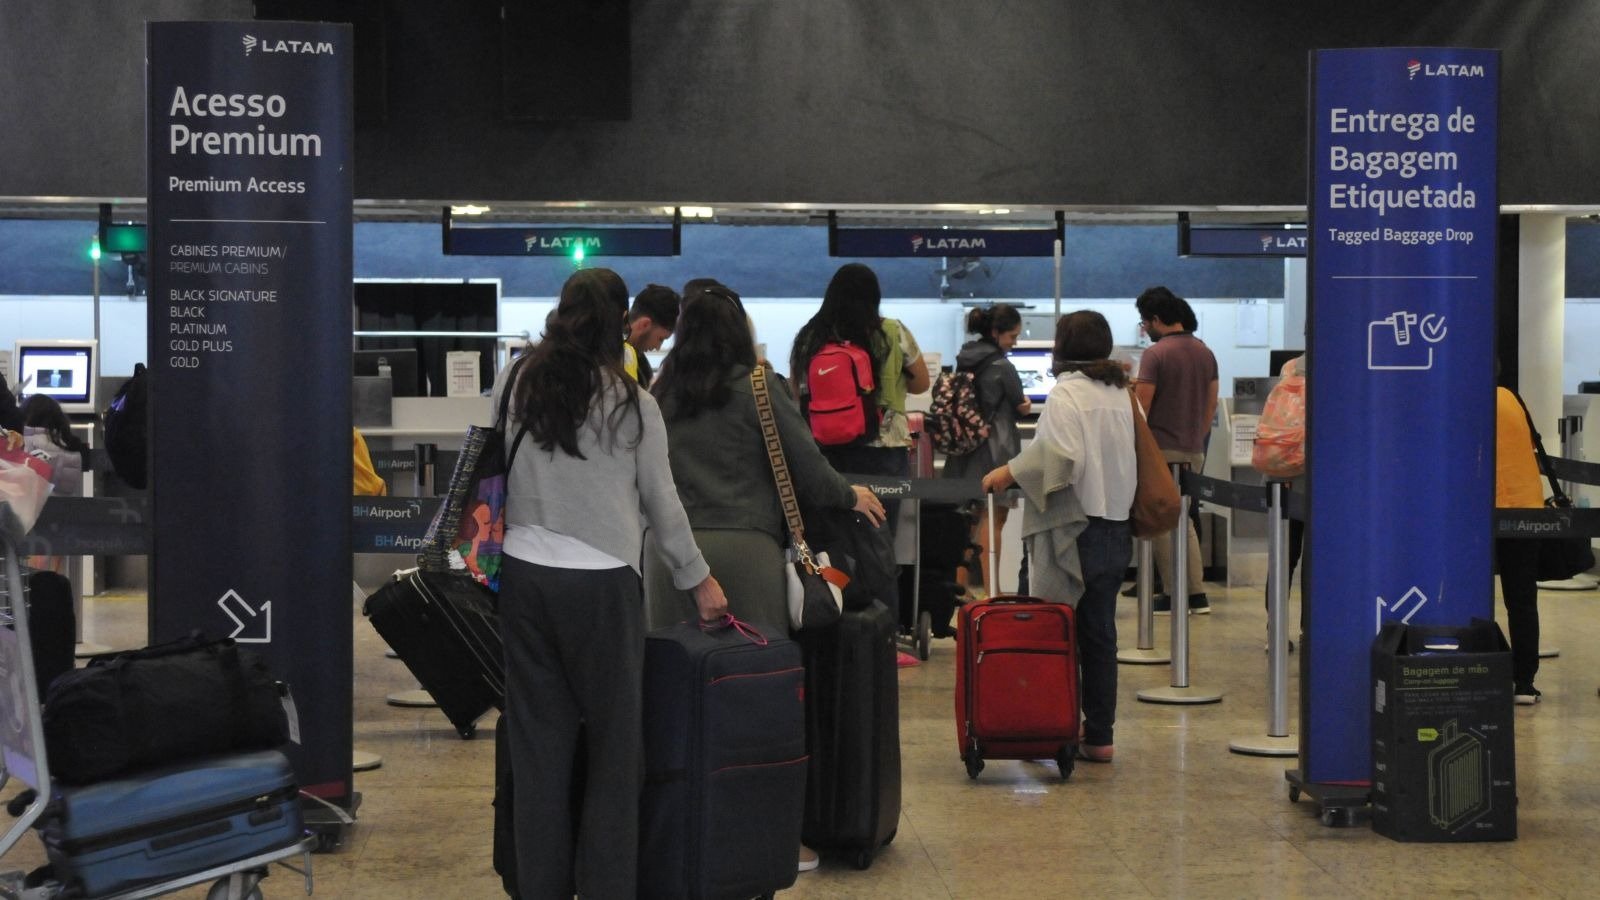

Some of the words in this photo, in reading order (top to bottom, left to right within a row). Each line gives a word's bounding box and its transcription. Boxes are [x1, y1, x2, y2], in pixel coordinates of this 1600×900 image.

[262, 40, 334, 55] LATAM
[1425, 64, 1484, 77] LATAM
[170, 86, 286, 118] Acesso
[1330, 108, 1440, 140] Entrega
[1447, 106, 1475, 133] de
[170, 124, 322, 156] Premium
[1330, 146, 1458, 179] Bagagem
[169, 176, 242, 192] Premium
[247, 177, 306, 193] Access
[1330, 182, 1476, 216] Etiquetada
[540, 236, 601, 248] LATAM
[927, 238, 986, 249] LATAM
[1276, 237, 1307, 248] LAT
[1328, 228, 1380, 245] Tagged
[1383, 228, 1443, 245] Baggage
[1446, 228, 1474, 245] Drop
[170, 245, 218, 257] CABINES
[221, 245, 287, 258] PREMIUM/
[170, 261, 222, 274] PREMIUM
[224, 262, 269, 275] CABINS
[170, 289, 205, 301] BLACK
[208, 290, 278, 303] SIGNATURE
[170, 306, 205, 318] BLACK
[170, 323, 227, 335] PLATINUM
[170, 340, 199, 352] GOLD
[202, 340, 233, 352] PLUS
[170, 356, 199, 368] GOLD
[352, 505, 412, 519] BHAirport
[1499, 519, 1561, 533] BHAirport
[375, 535, 422, 550] BHAirp
[1402, 666, 1450, 677] Bagagem
[1452, 665, 1465, 675] de
[1468, 663, 1489, 674] mão
